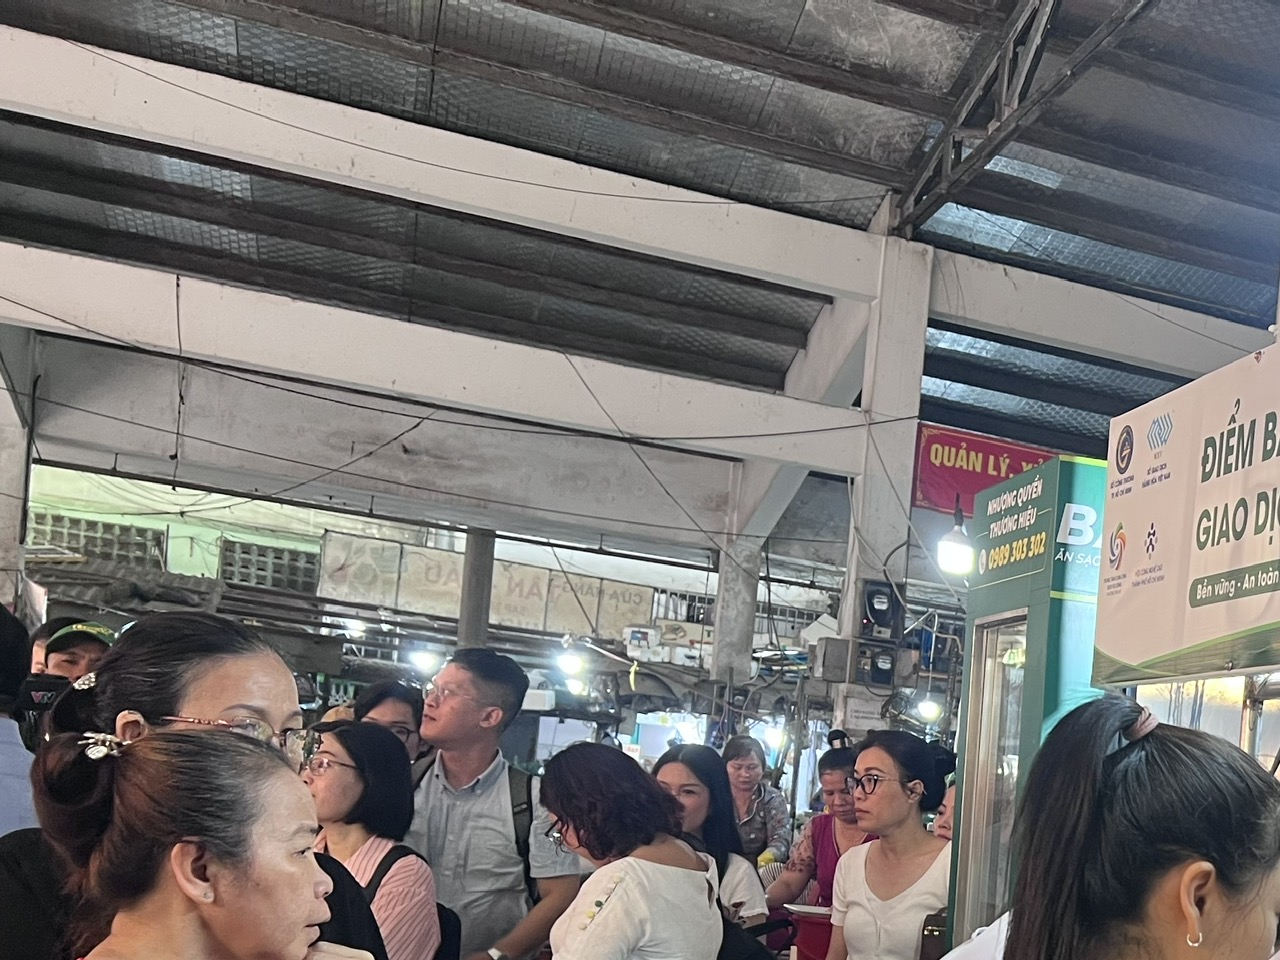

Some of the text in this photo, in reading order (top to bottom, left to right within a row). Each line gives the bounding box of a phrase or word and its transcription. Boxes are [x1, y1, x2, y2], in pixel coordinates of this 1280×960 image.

[930, 442, 983, 473] QUẢN
[1201, 397, 1256, 483] ĐIỂM
[987, 491, 1017, 516] NHƯỢNG
[989, 504, 1037, 539] THƯƠNG HIỆU
[1056, 503, 1102, 549] B
[1196, 497, 1249, 551] GIAO
[988, 531, 1046, 570] 0989 303 302
[1054, 548, 1074, 563] ĂN
[1196, 576, 1212, 599] Bền
[1214, 579, 1236, 597] vững
[1242, 573, 1256, 590] An
[1258, 569, 1279, 587] toàn
